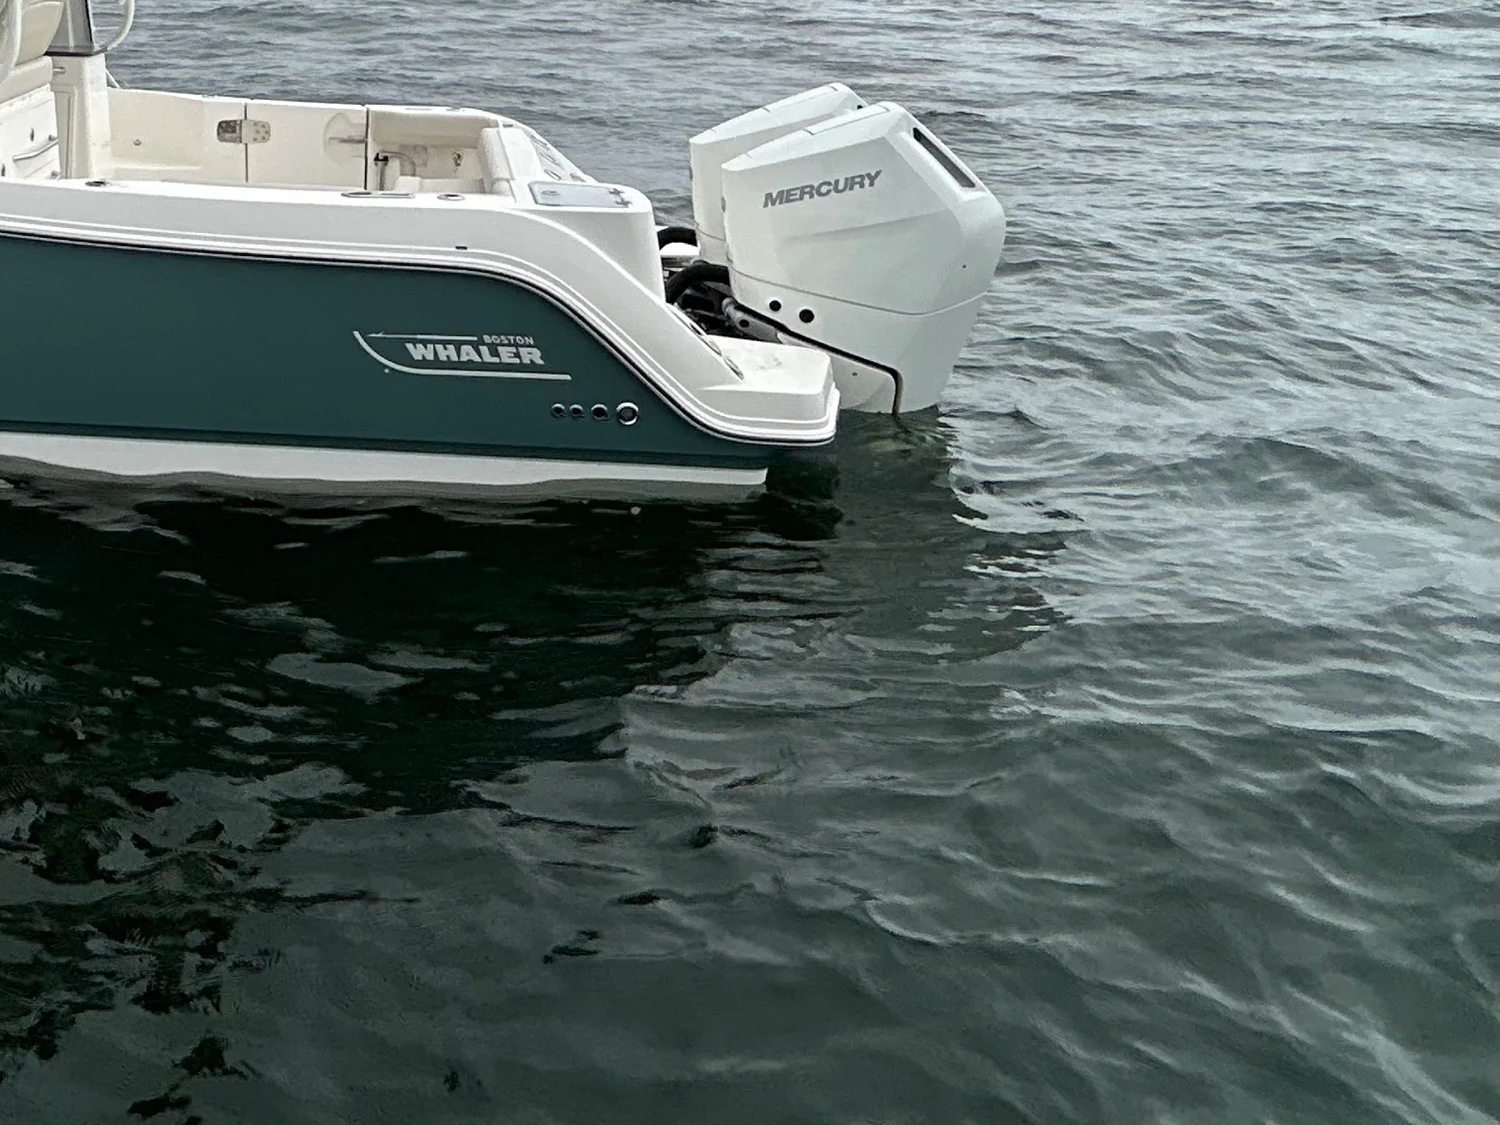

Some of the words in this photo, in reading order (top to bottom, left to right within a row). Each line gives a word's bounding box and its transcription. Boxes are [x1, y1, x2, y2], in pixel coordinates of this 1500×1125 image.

[762, 170, 883, 208] MERCURY
[482, 334, 535, 345] BOSTON
[404, 342, 545, 365] WHALER
